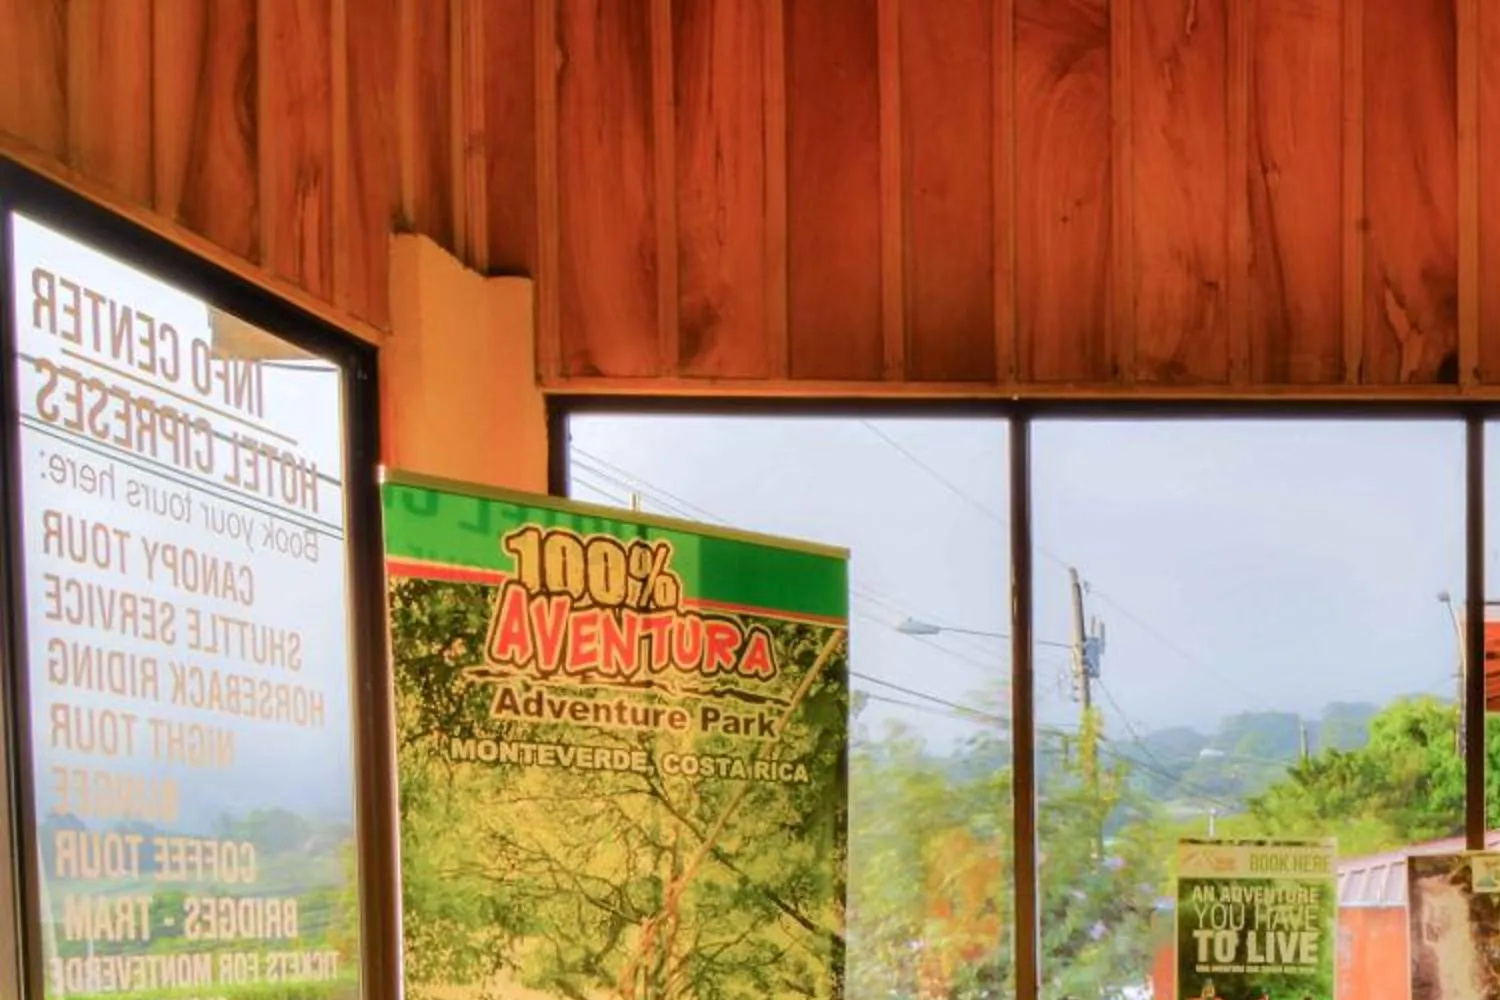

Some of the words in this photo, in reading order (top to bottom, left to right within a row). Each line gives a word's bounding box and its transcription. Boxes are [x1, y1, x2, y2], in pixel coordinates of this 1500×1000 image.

[503, 523, 682, 608] 100%
[488, 581, 778, 682] AVENTURA
[493, 688, 687, 731] Adventure
[702, 709, 780, 739] Park
[663, 753, 746, 779] COSTA
[1192, 886, 1215, 902] AN
[1220, 886, 1320, 904] ADVENTURE
[1194, 903, 1245, 931] YOU
[1255, 904, 1319, 931] HAVE
[1192, 930, 1239, 963] TO
[1247, 931, 1320, 963] LIVE
